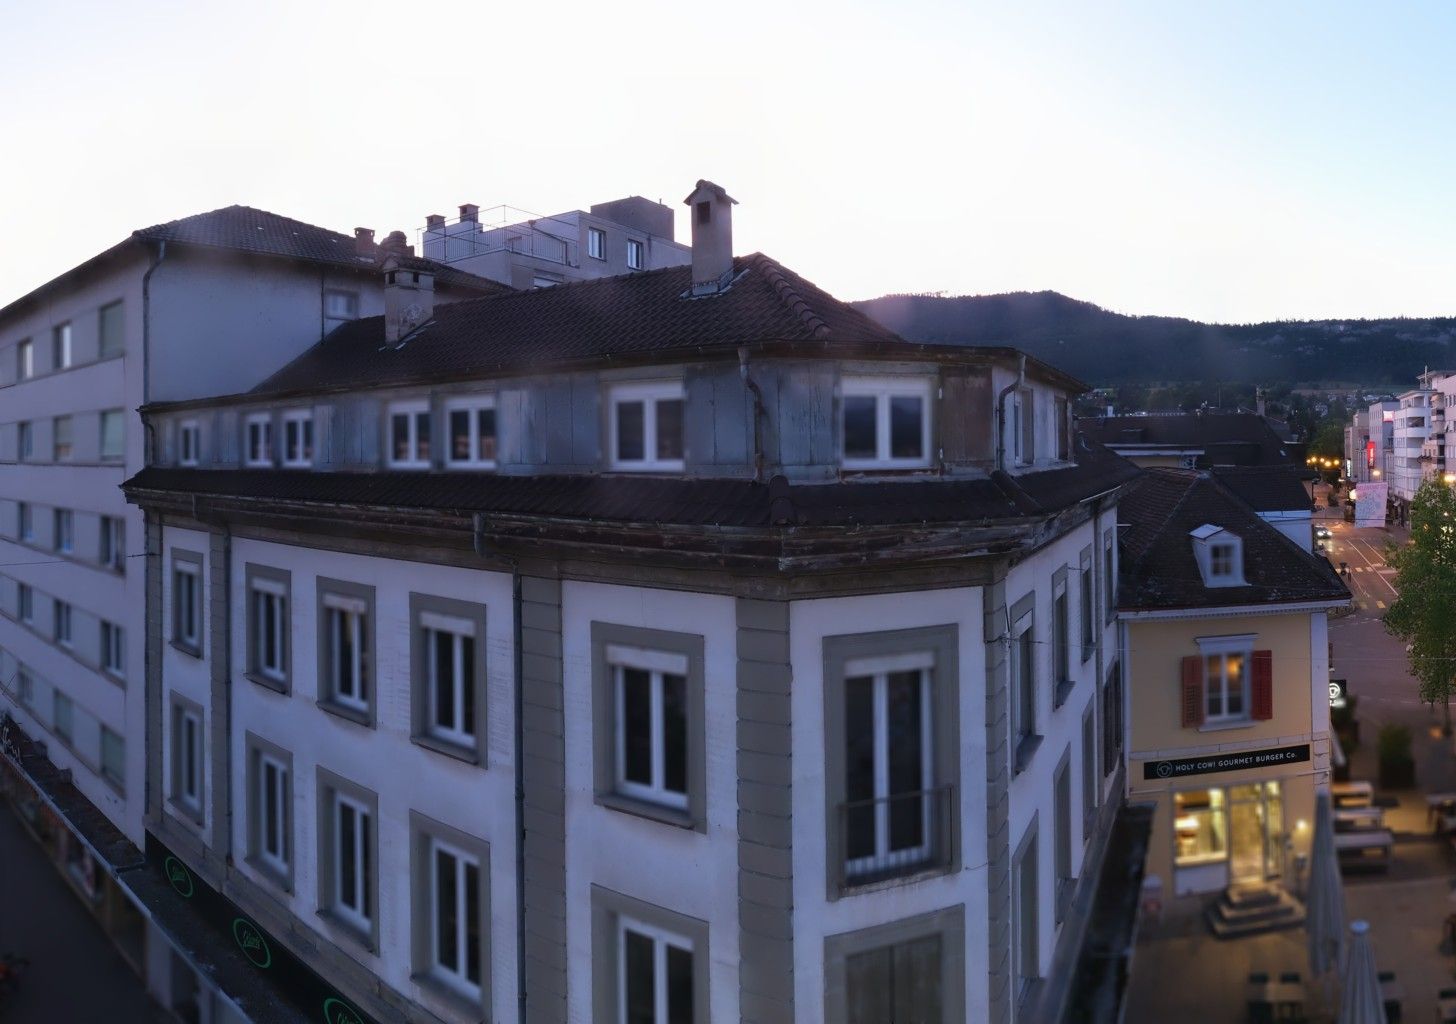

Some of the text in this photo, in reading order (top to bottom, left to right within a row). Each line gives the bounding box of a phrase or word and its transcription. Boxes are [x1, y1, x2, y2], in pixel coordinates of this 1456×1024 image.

[1175, 764, 1195, 772] HOLY
[1197, 761, 1216, 770] COW!
[1218, 757, 1253, 767] GOURMET
[1255, 753, 1284, 763] BURGER
